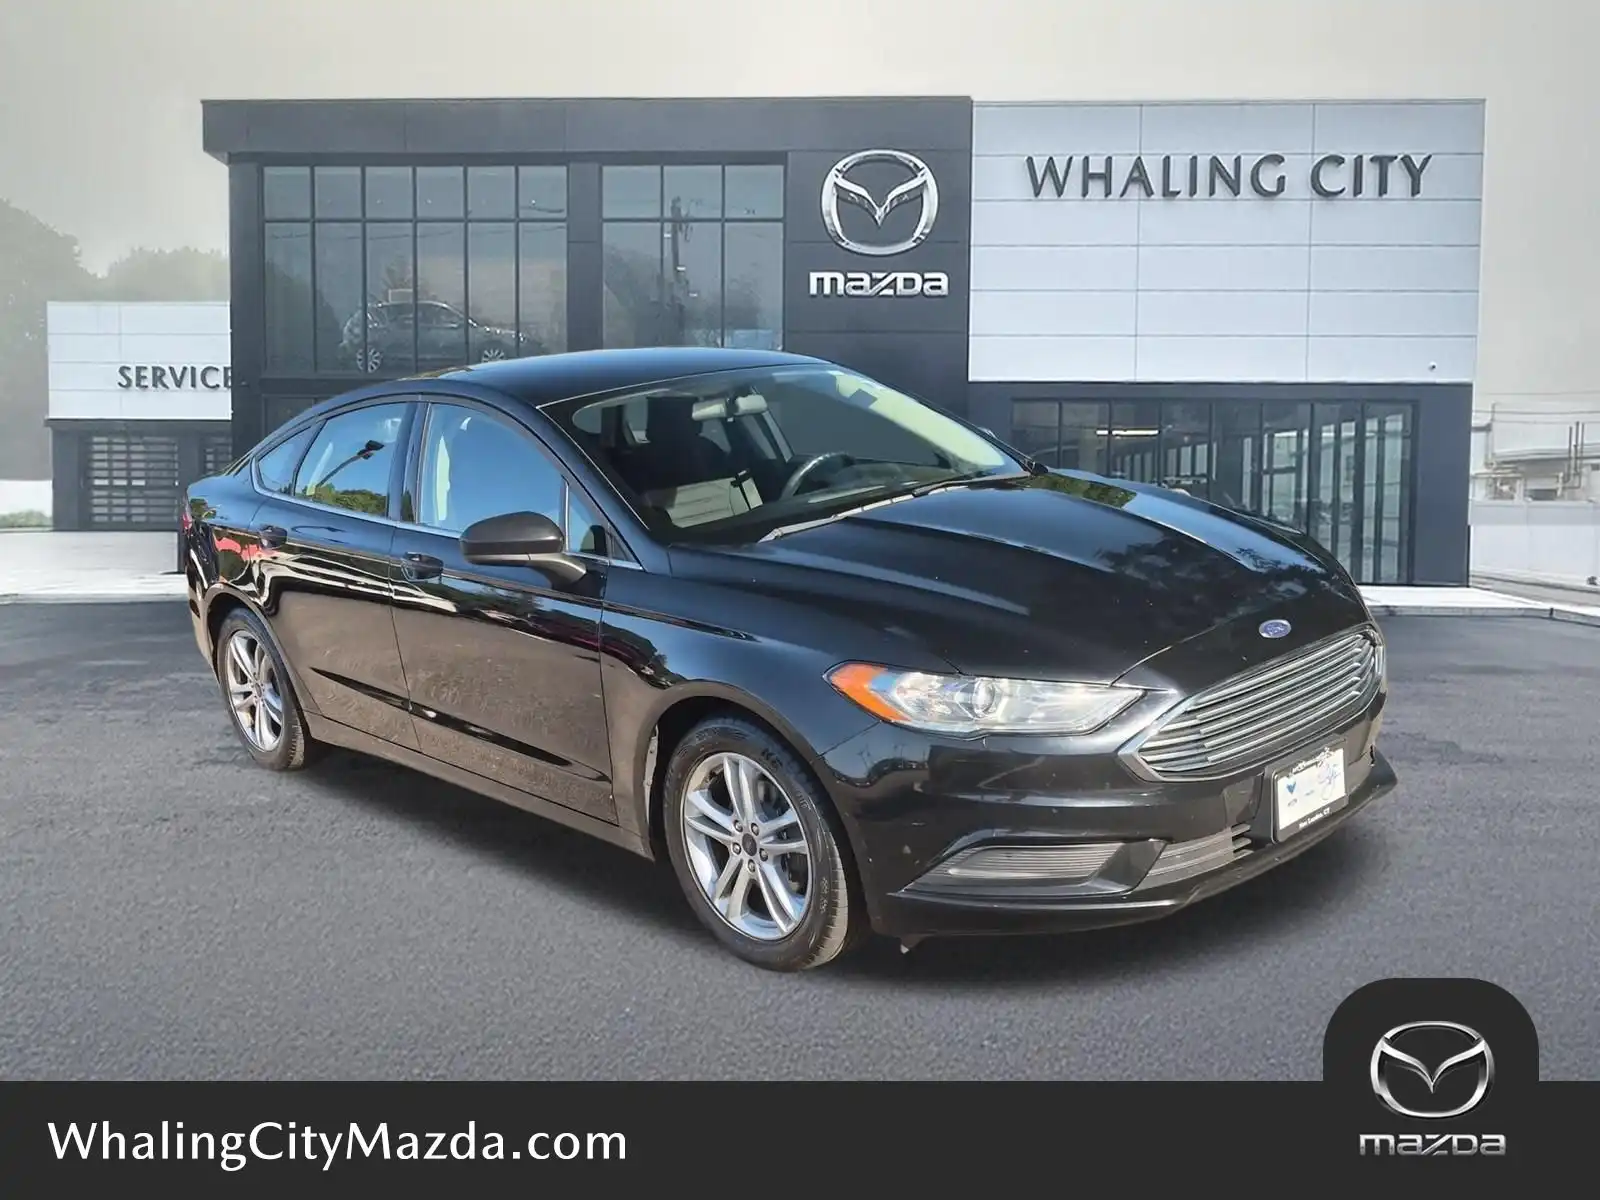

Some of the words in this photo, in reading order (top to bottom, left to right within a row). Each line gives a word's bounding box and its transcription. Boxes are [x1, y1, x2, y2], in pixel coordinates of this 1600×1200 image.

[1026, 154, 1286, 198] WHALING
[1310, 153, 1433, 199] CITY
[808, 271, 949, 297] mazda
[117, 365, 232, 390] SERVICE
